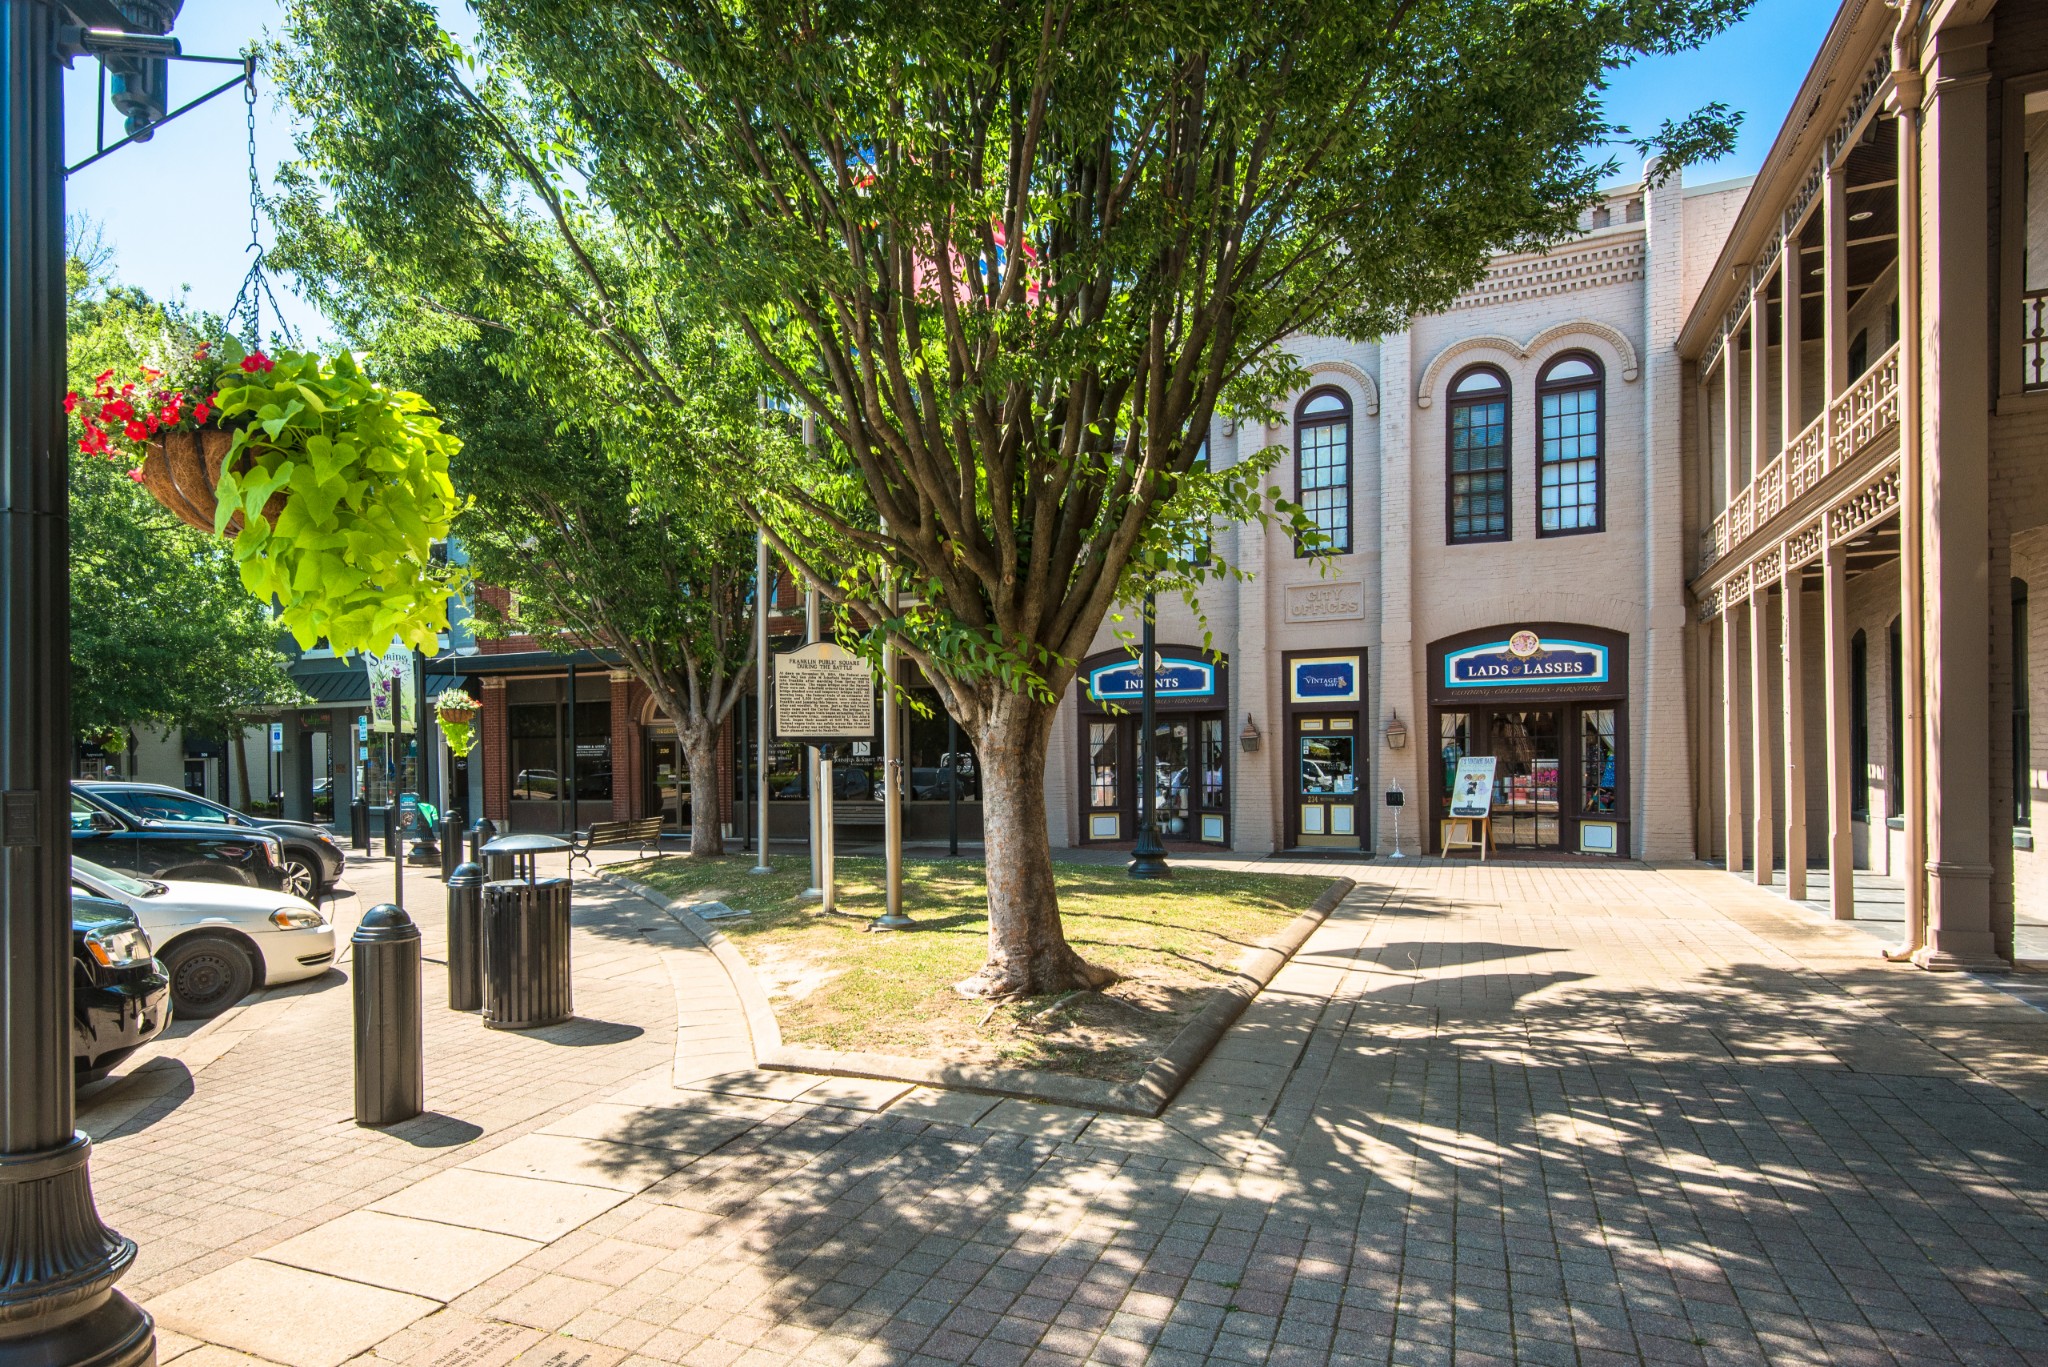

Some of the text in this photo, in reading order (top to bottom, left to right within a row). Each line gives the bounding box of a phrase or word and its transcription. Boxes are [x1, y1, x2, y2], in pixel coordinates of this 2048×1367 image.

[1306, 589, 1342, 602] CITY
[1292, 602, 1358, 616] OFFICES
[1468, 662, 1583, 677] LADS & LASSES
[1124, 678, 1179, 690] INNTS
[1303, 676, 1338, 684] VINTAGE
[1451, 685, 1602, 697] CLOTHING COLLECTIBLES FURNITURE
[854, 742, 869, 755] JS
[1307, 795, 1319, 803] 234
